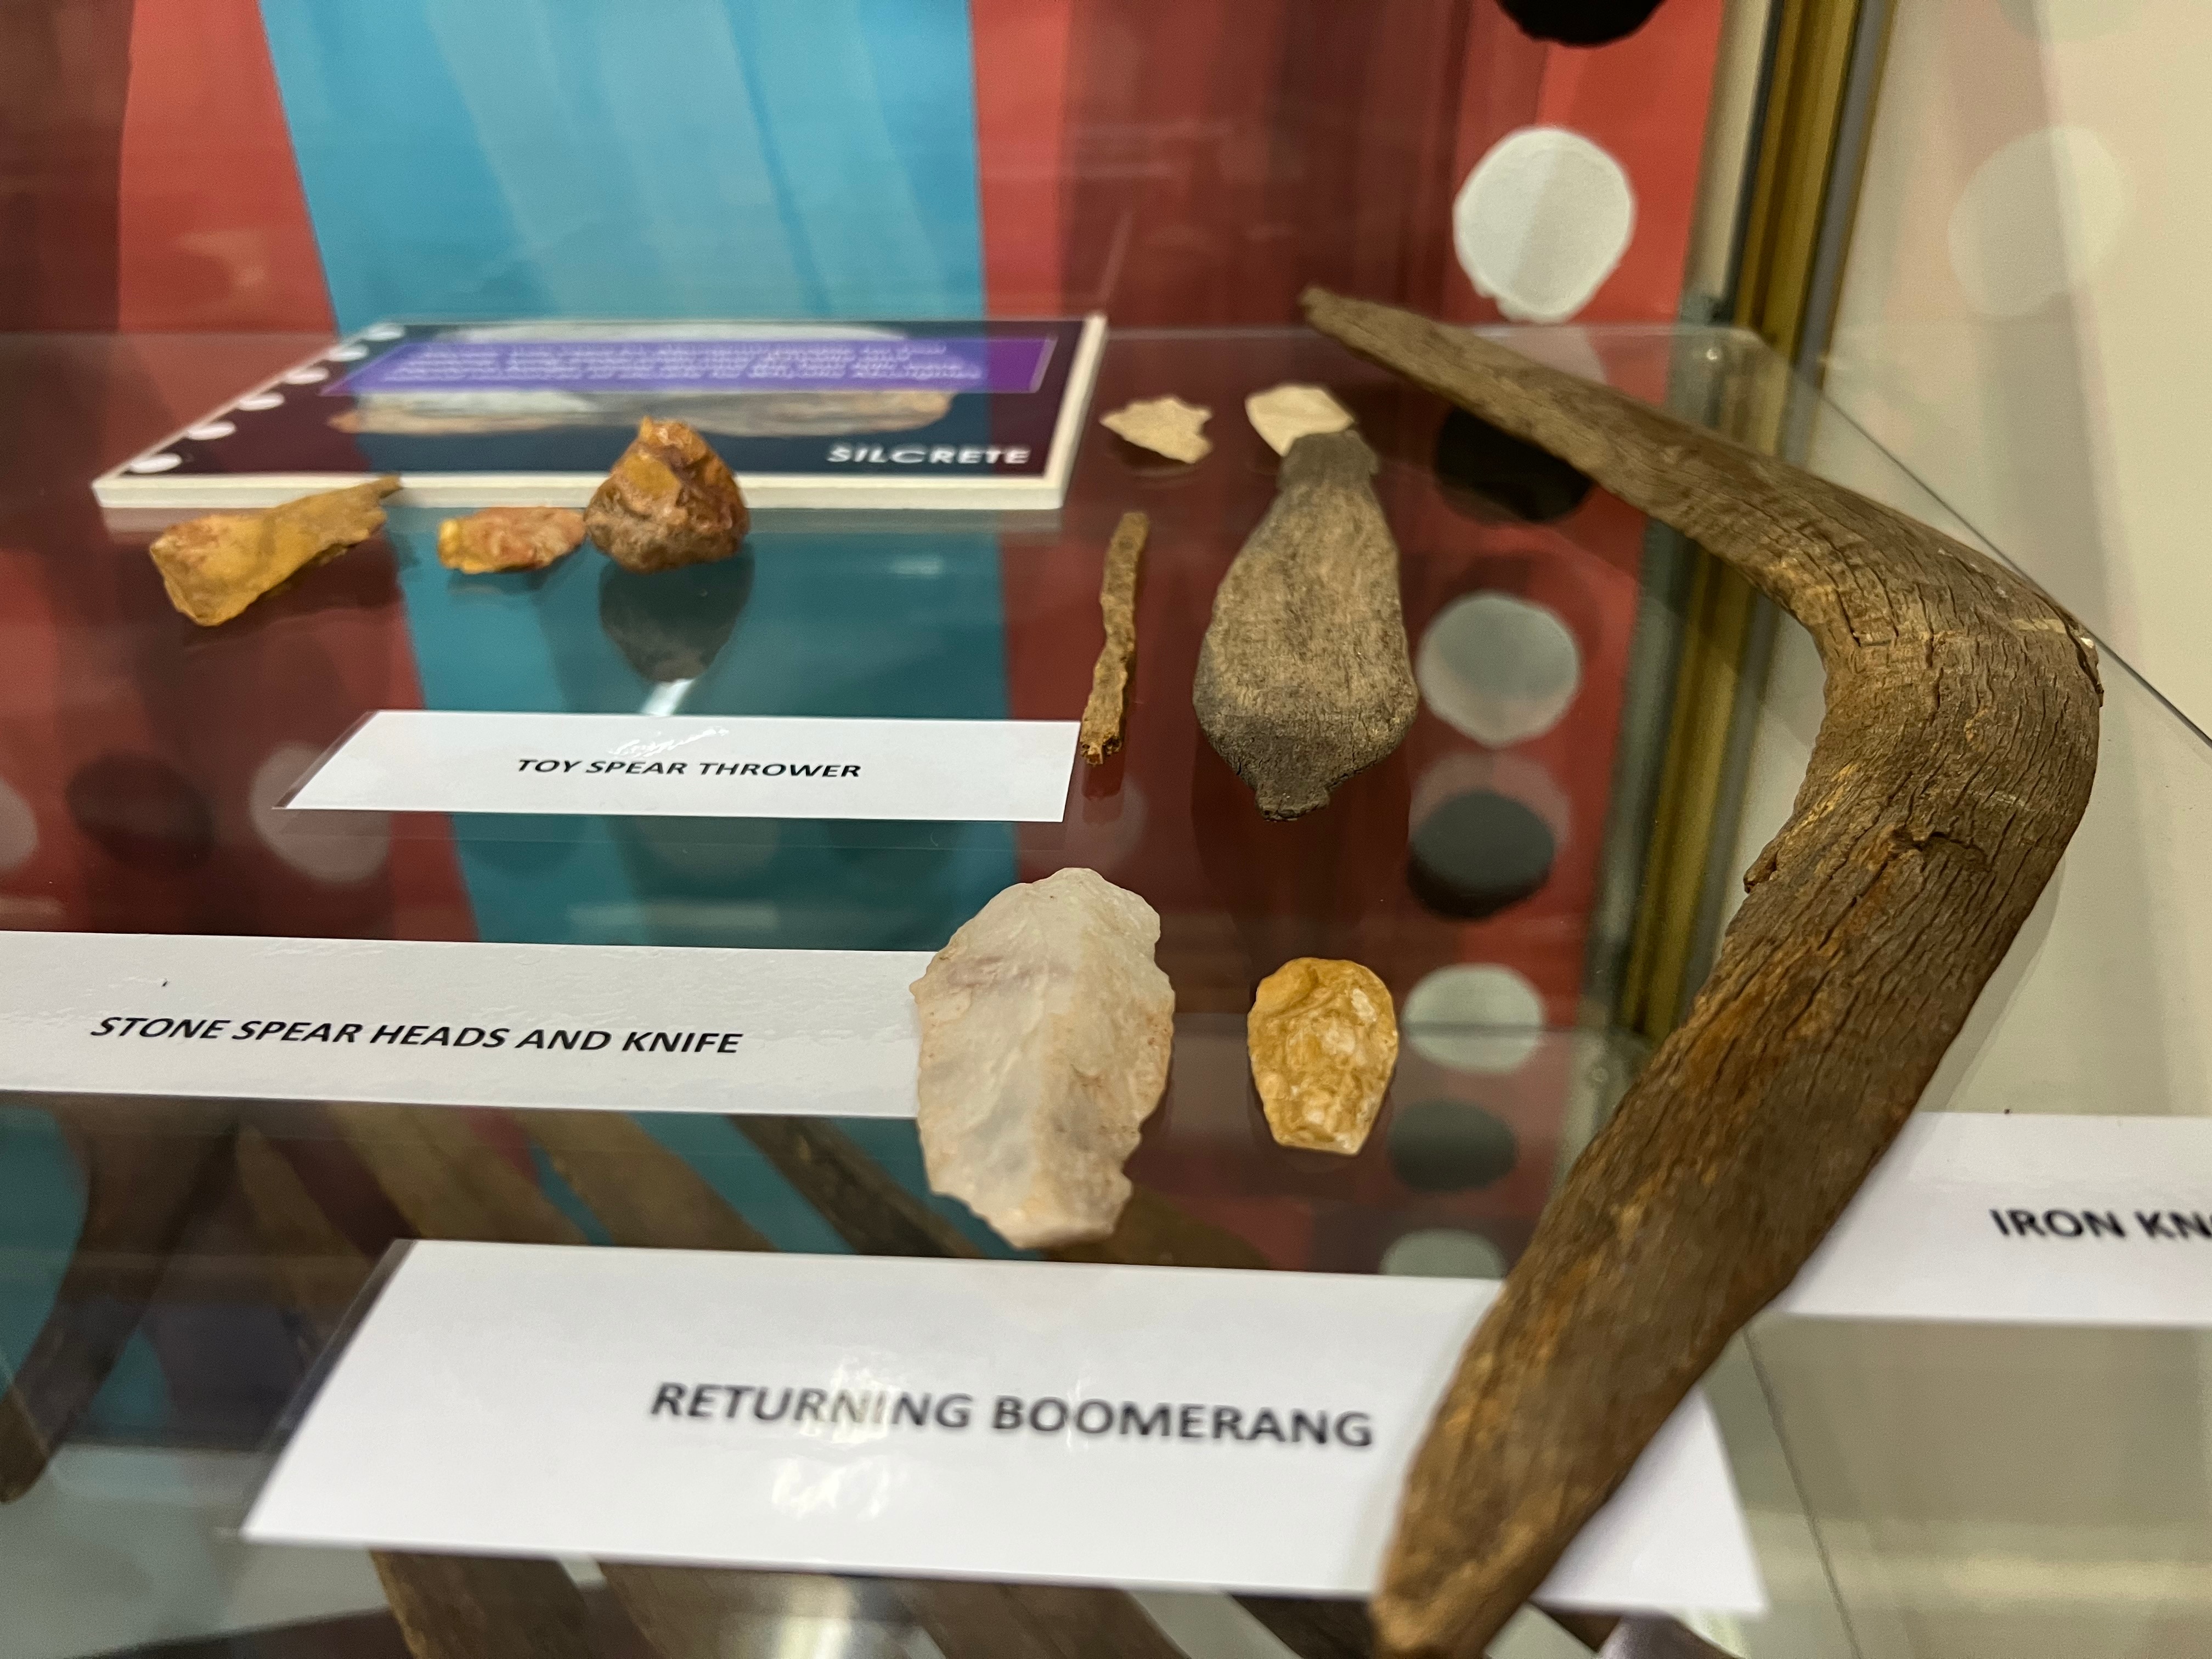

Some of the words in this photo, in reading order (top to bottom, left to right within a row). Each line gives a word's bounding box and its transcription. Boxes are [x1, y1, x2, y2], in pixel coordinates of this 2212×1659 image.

[826, 443, 1031, 465] SILCRETE
[518, 759, 583, 773] TOY
[585, 760, 688, 775] SPEAR
[699, 763, 862, 778] THROWER
[90, 1016, 230, 1040] STONE
[232, 1020, 363, 1045] SPEAR
[369, 1024, 507, 1049] HEADS
[514, 1029, 612, 1051] AND
[621, 1031, 744, 1054] KNIFE
[1988, 1208, 2128, 1240] IRON
[2133, 1209, 2212, 1240] KN
[650, 1381, 973, 1430] RETURNING
[991, 1396, 1374, 1448] BOOMERANG
